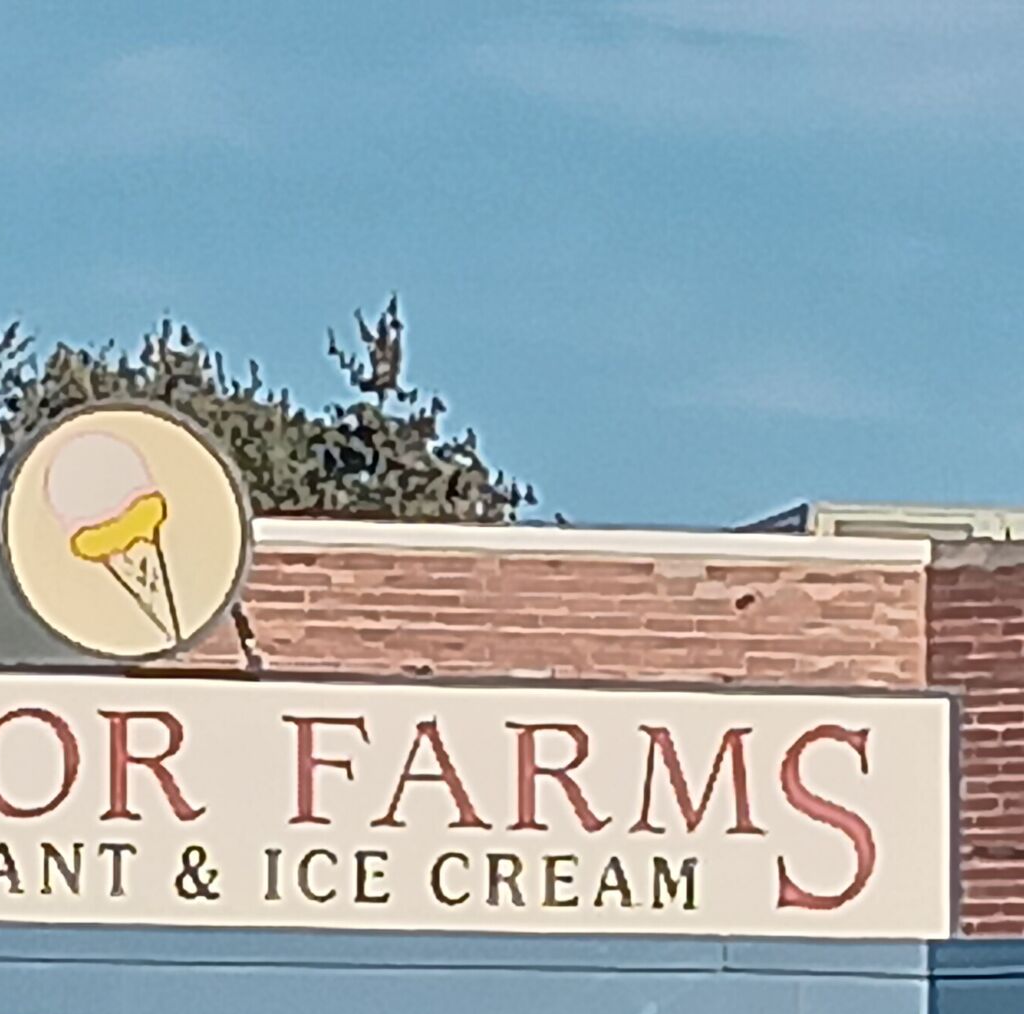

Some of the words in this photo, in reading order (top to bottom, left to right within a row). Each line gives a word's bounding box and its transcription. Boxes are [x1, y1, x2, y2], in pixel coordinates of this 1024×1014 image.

[282, 716, 875, 910] FARMS
[175, 846, 220, 900] &
[265, 849, 390, 903] ICE
[431, 854, 697, 910] CREAM
